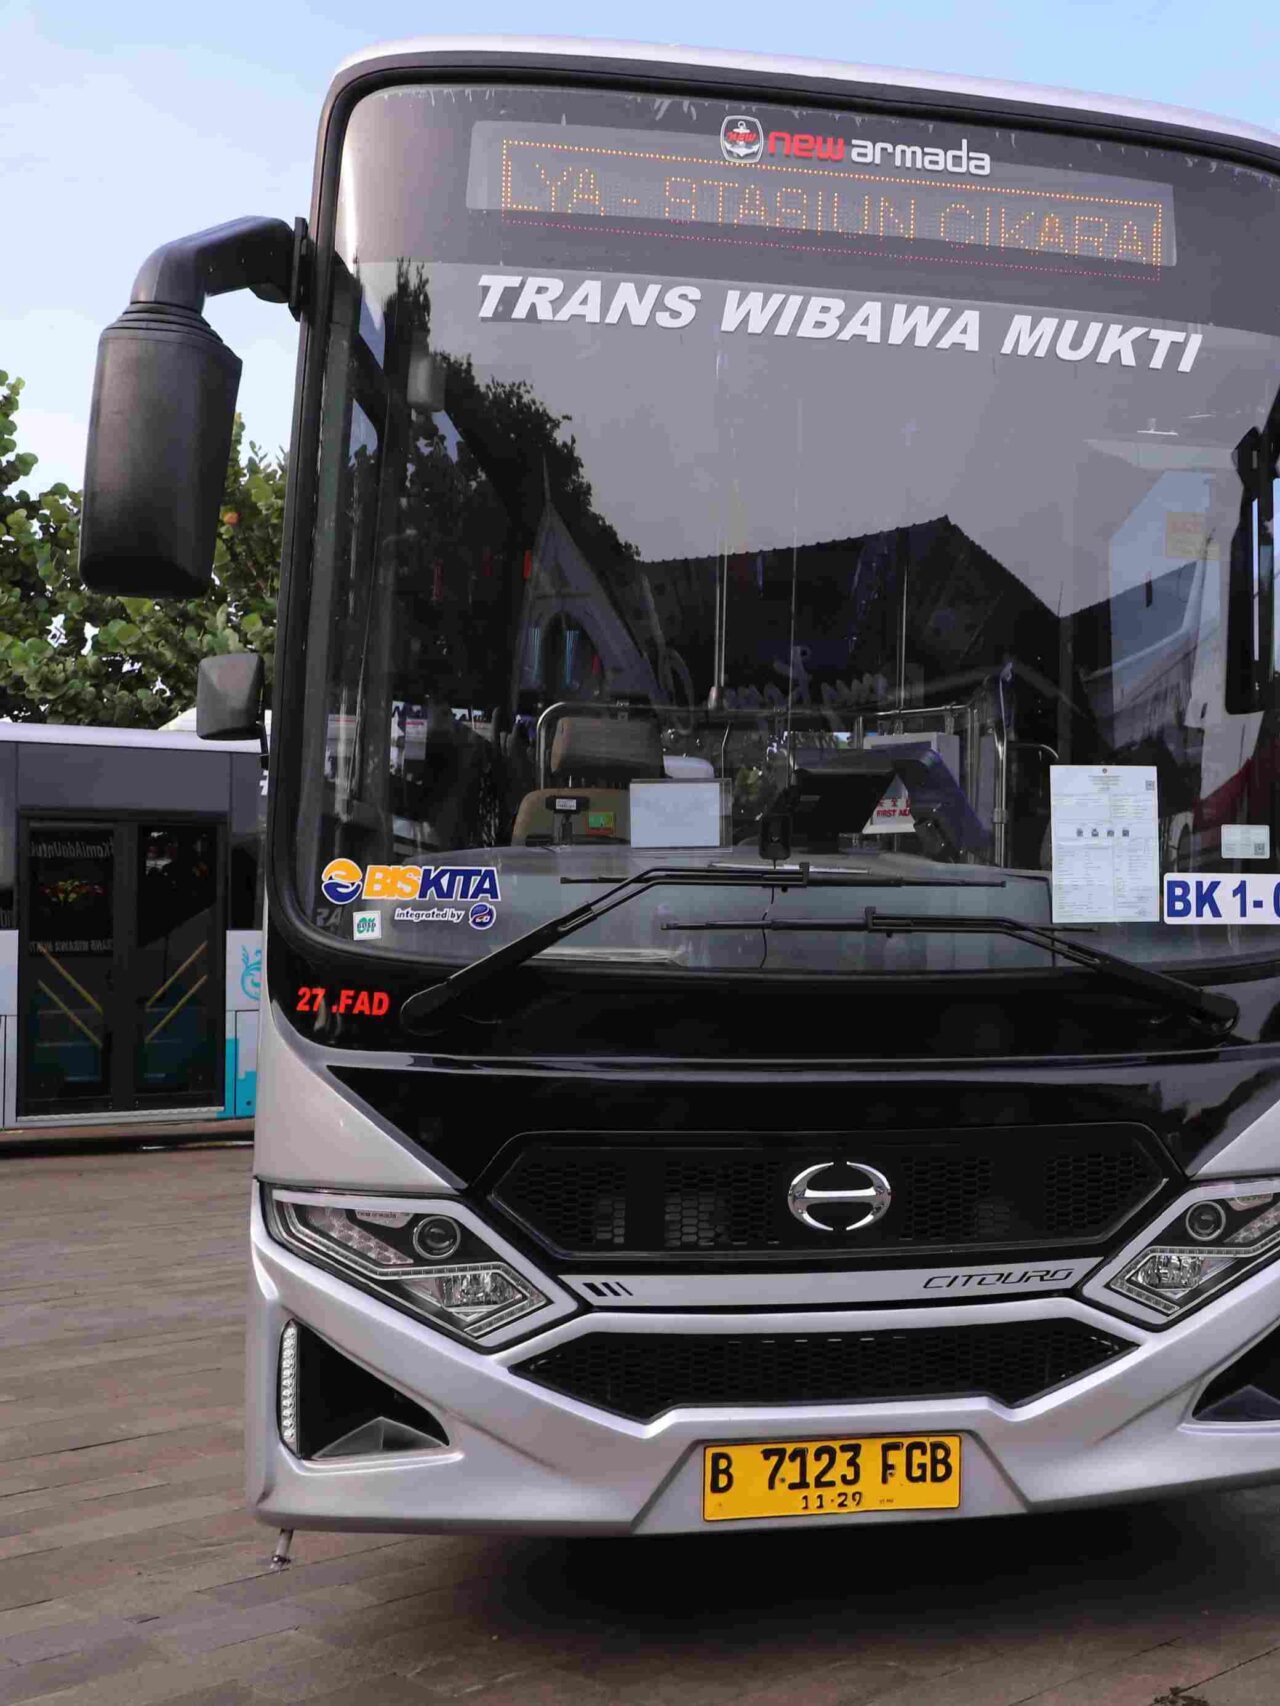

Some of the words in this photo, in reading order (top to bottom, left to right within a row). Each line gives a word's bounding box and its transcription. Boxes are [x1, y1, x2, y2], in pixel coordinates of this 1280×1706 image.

[768, 130, 845, 163] new
[851, 130, 991, 176] armada
[477, 274, 701, 329] TRANS
[720, 290, 982, 352] WIBAWA
[1000, 314, 1203, 373] MUKTI
[396, 907, 448, 922] integrated
[450, 908, 463, 923] by
[1166, 880, 1223, 918] BK
[296, 986, 326, 1012] 27
[710, 1452, 734, 1494] B
[760, 1443, 862, 1491] 7123
[881, 1440, 953, 1485] FGB
